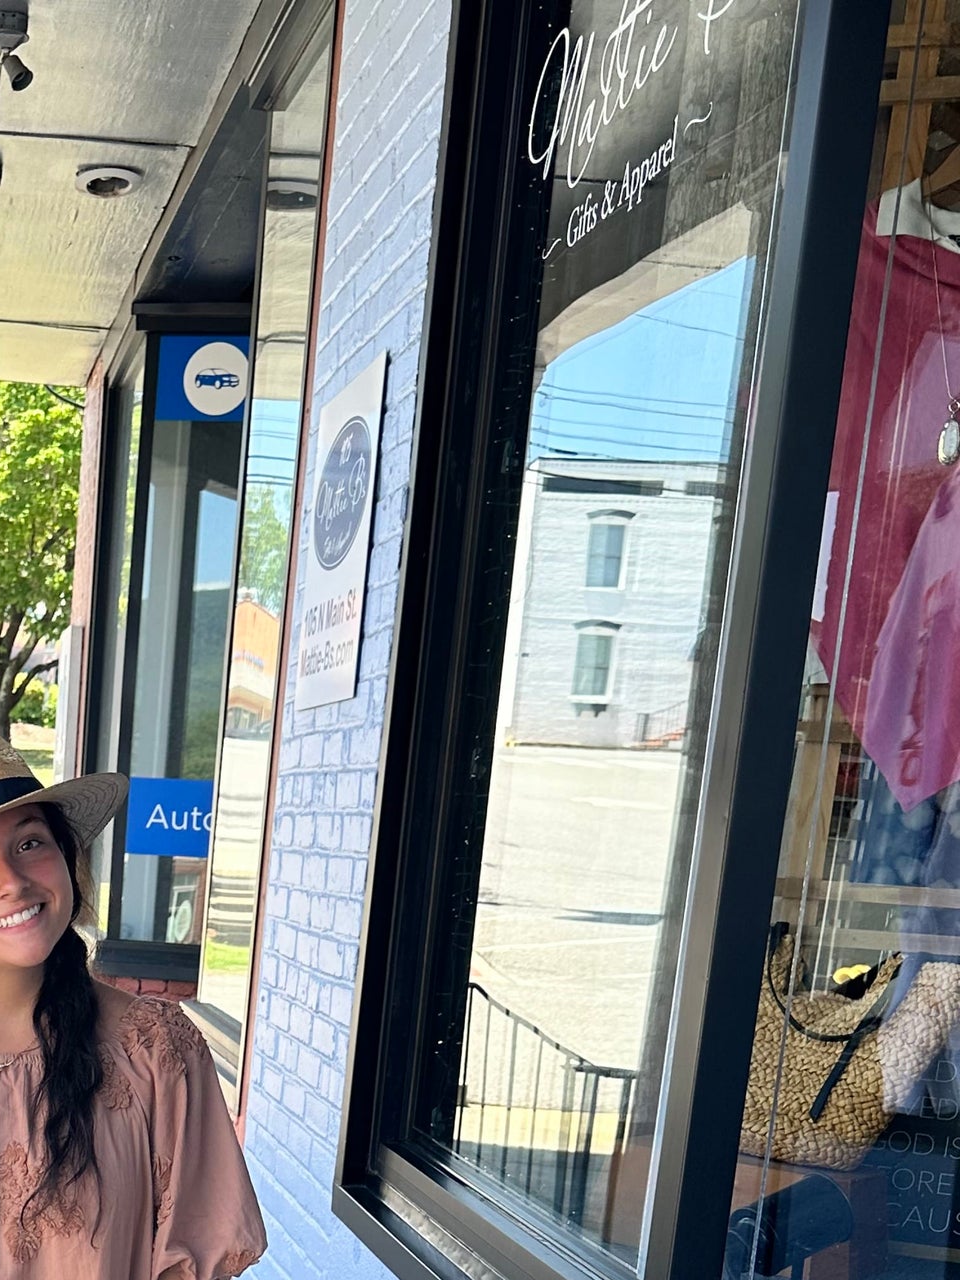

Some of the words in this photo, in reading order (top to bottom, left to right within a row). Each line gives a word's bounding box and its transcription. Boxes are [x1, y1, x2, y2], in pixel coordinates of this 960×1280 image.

[528, 0, 678, 188] Mattie
[567, 193, 598, 247] Gifts
[601, 180, 617, 220] &
[617, 115, 679, 212] Apparel
[304, 606, 318, 638] 105
[317, 602, 326, 632] N
[325, 595, 345, 630] Main
